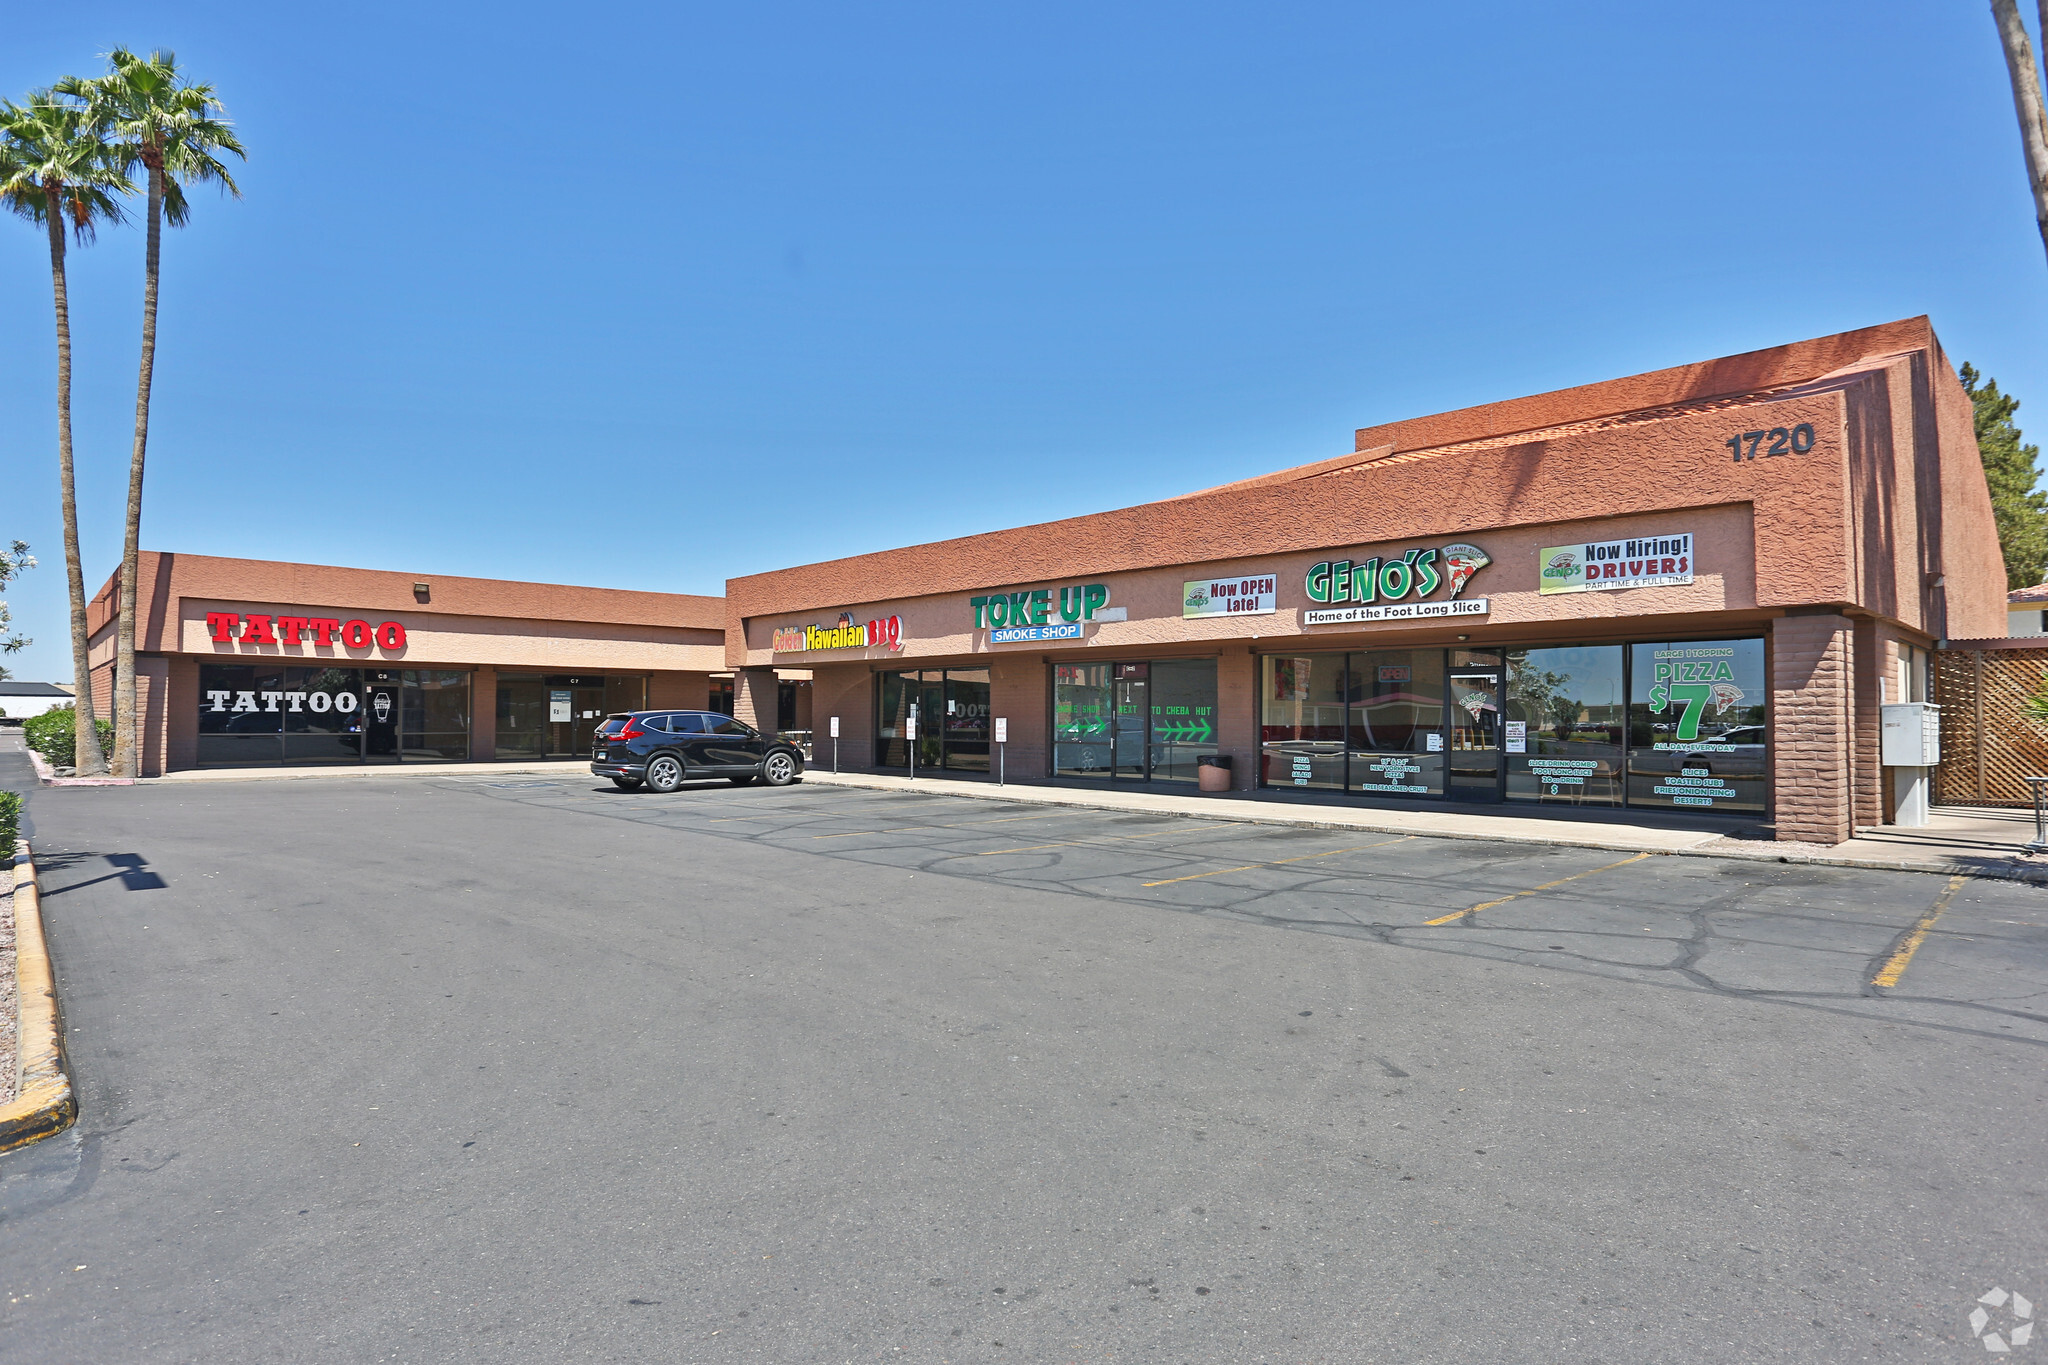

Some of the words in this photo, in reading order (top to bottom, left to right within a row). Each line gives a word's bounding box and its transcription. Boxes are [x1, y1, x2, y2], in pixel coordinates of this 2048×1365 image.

[1726, 423, 1815, 462] 1720
[1585, 545, 1620, 561] Now
[1626, 536, 1688, 557] Hiring!
[1543, 563, 1582, 578] GENO'S
[1585, 556, 1689, 580] DRIVERS
[1305, 549, 1440, 604] GENO'S
[1585, 581, 1607, 589] PART
[1611, 580, 1630, 588] TIME
[1643, 576, 1664, 585] FULL
[1668, 575, 1689, 583] TIME
[1210, 583, 1237, 598] Now
[1241, 578, 1273, 595] OPEN
[970, 590, 1052, 629] TOKE
[1060, 584, 1110, 621] UP
[1227, 596, 1259, 612] Late!
[1309, 612, 1342, 622] Home
[1345, 609, 1358, 619] of
[1361, 607, 1380, 618] the
[1384, 606, 1412, 617] Foot
[1417, 604, 1448, 616] Long
[1452, 602, 1481, 613] Slice
[207, 612, 406, 650] TATTOO
[773, 627, 803, 653] Golden
[806, 625, 864, 650] Hawaiian
[868, 615, 902, 652] BBQ
[995, 628, 1037, 641] SMOKE
[1041, 625, 1077, 638] SHOP
[1655, 650, 1683, 658] LARGE
[1686, 649, 1691, 657] 1
[1693, 648, 1733, 657] TOPPING
[1381, 669, 1409, 679] OPEN
[1655, 661, 1734, 682] PIZZA
[207, 690, 358, 713] TATTOO
[1082, 705, 1100, 713] SHOP
[1119, 705, 1138, 713] NEXT
[1152, 706, 1161, 714] TO
[1166, 706, 1190, 715] CHEBA
[1195, 706, 1211, 715] HUT
[1653, 743, 1668, 752] ALL
[1670, 743, 1689, 753] DAY,
[1690, 744, 1716, 753] EVERY
[1717, 744, 1736, 754] DAY
[1553, 768, 1573, 776] LONG
[1682, 768, 1708, 776] SLICES
[1551, 784, 1558, 795] $
[1665, 777, 1702, 785] TOASTED
[1703, 779, 1724, 787] SUBS
[1654, 786, 1707, 795] FRIES/ONION
[1709, 788, 1735, 797] RINGS
[1674, 796, 1712, 805] DESSERTS
